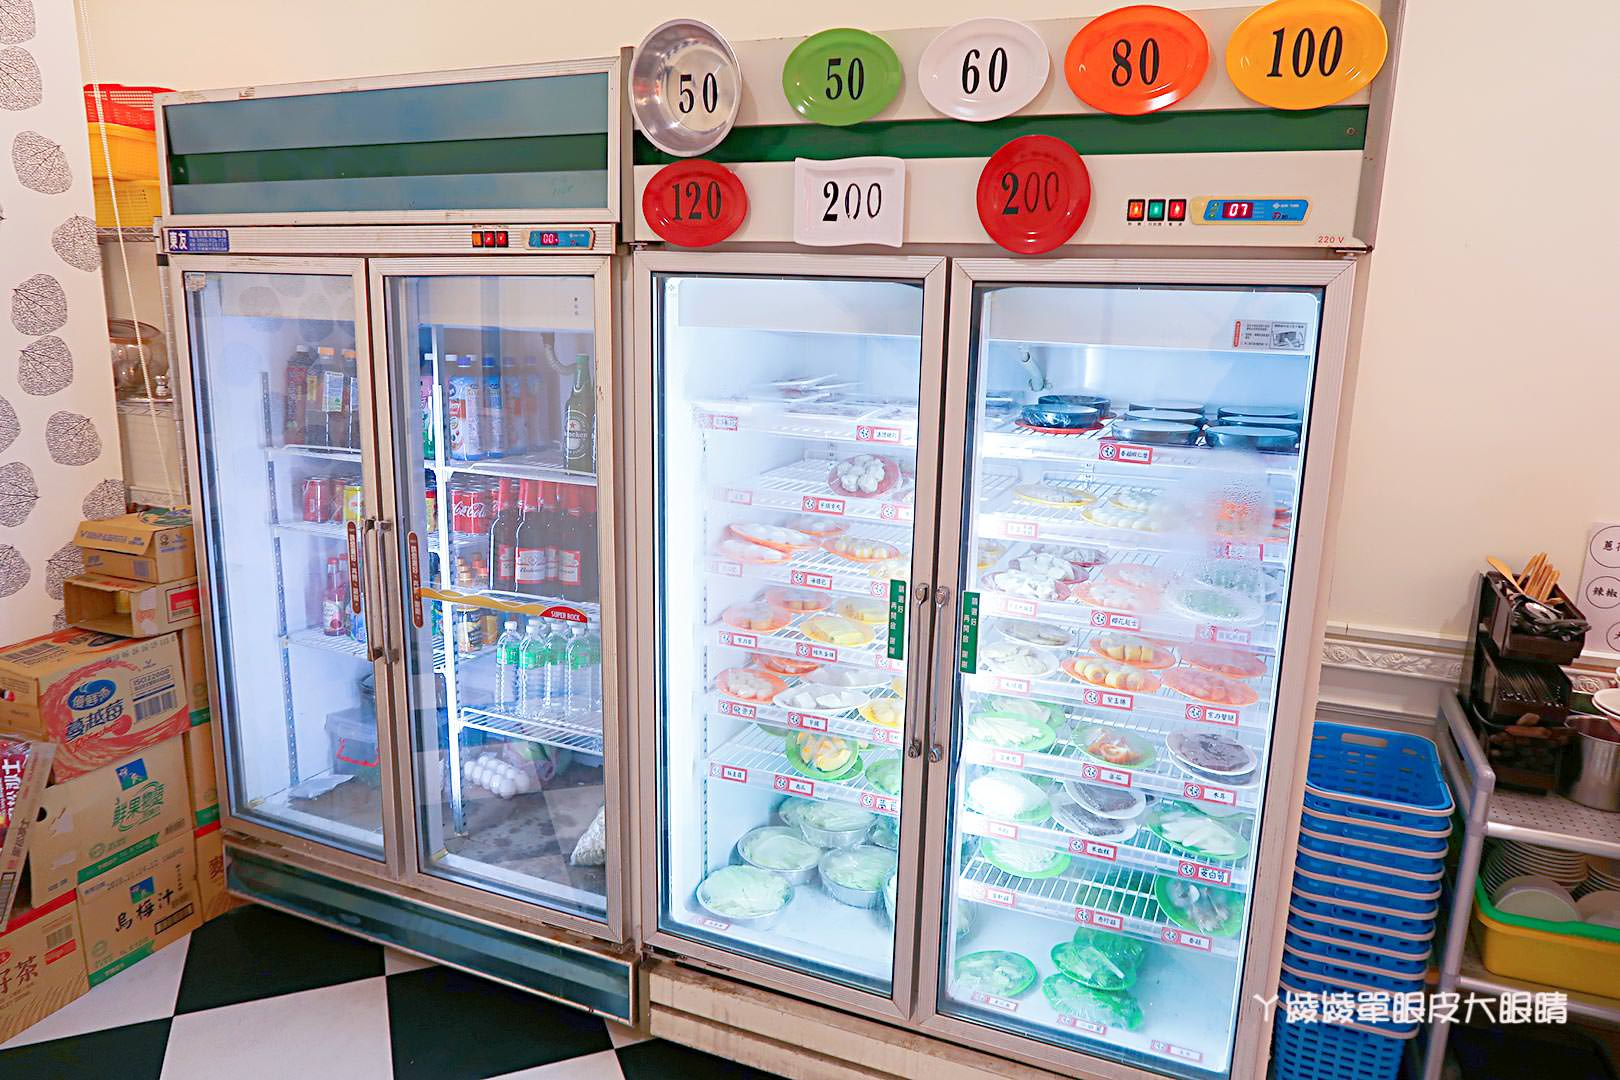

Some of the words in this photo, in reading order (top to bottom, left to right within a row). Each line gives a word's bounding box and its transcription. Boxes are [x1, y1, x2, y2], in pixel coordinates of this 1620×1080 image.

[962, 47, 1008, 94] 60
[1111, 37, 1160, 86] 80
[1267, 26, 1343, 78] 100
[678, 72, 718, 114] 50
[824, 57, 865, 101] 50
[671, 181, 722, 222] 120
[822, 181, 883, 223] 200
[1001, 171, 1060, 215] 200
[1229, 203, 1248, 216] 07
[1318, 235, 1335, 244] 220
[1594, 587, 1618, 598] 辣椒
[551, 610, 566, 619] SUPER
[115, 889, 174, 932] 烏梅汁
